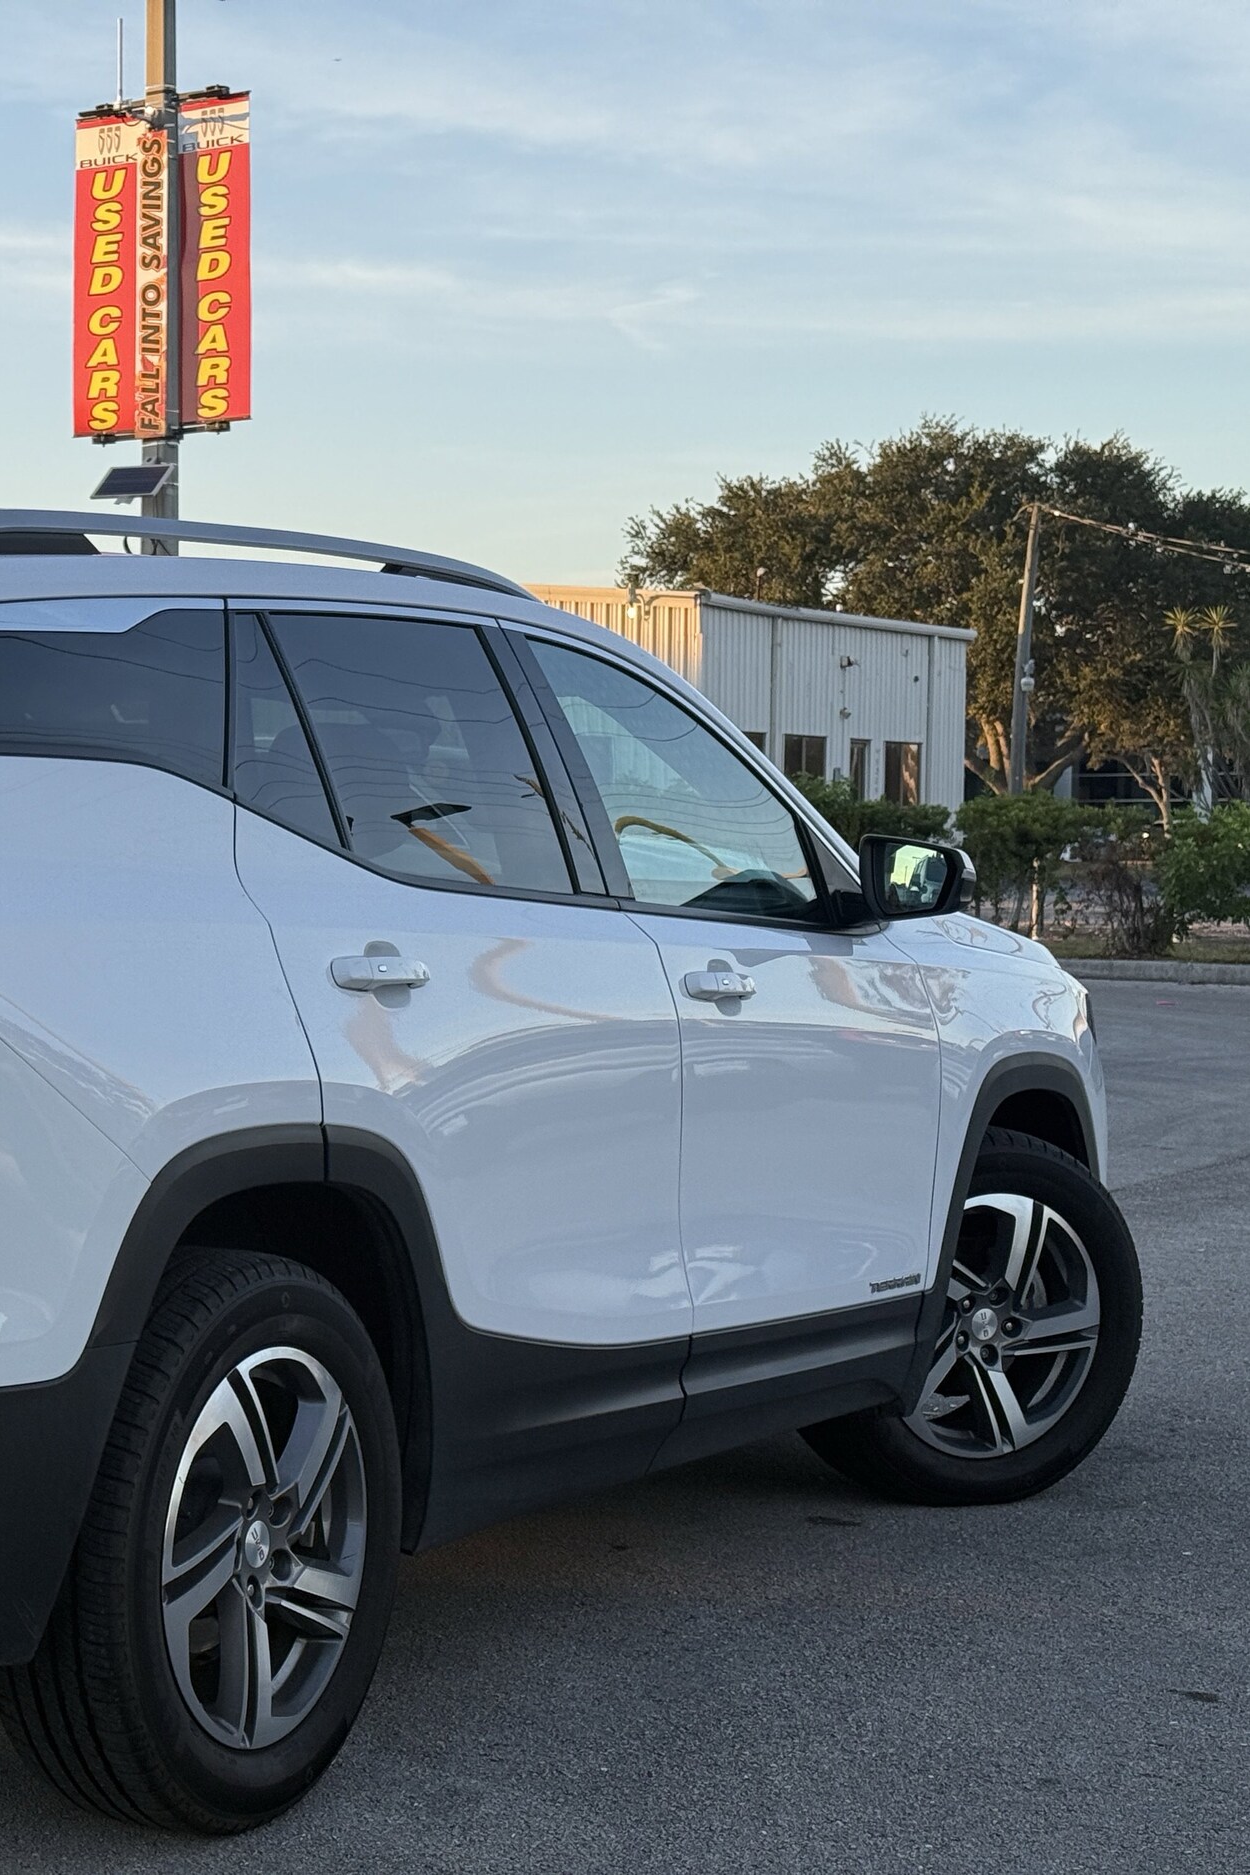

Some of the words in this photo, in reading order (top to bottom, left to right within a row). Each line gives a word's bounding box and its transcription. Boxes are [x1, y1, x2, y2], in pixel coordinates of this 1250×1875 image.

[80, 152, 139, 168] BUICK
[141, 138, 162, 271] SAVINGS
[182, 134, 244, 152] BUICK
[89, 168, 127, 296] USED
[196, 150, 233, 281] USED
[85, 305, 123, 431] CARS
[141, 283, 162, 354] INTO
[195, 290, 232, 418] CARS
[140, 367, 160, 431] FALL
